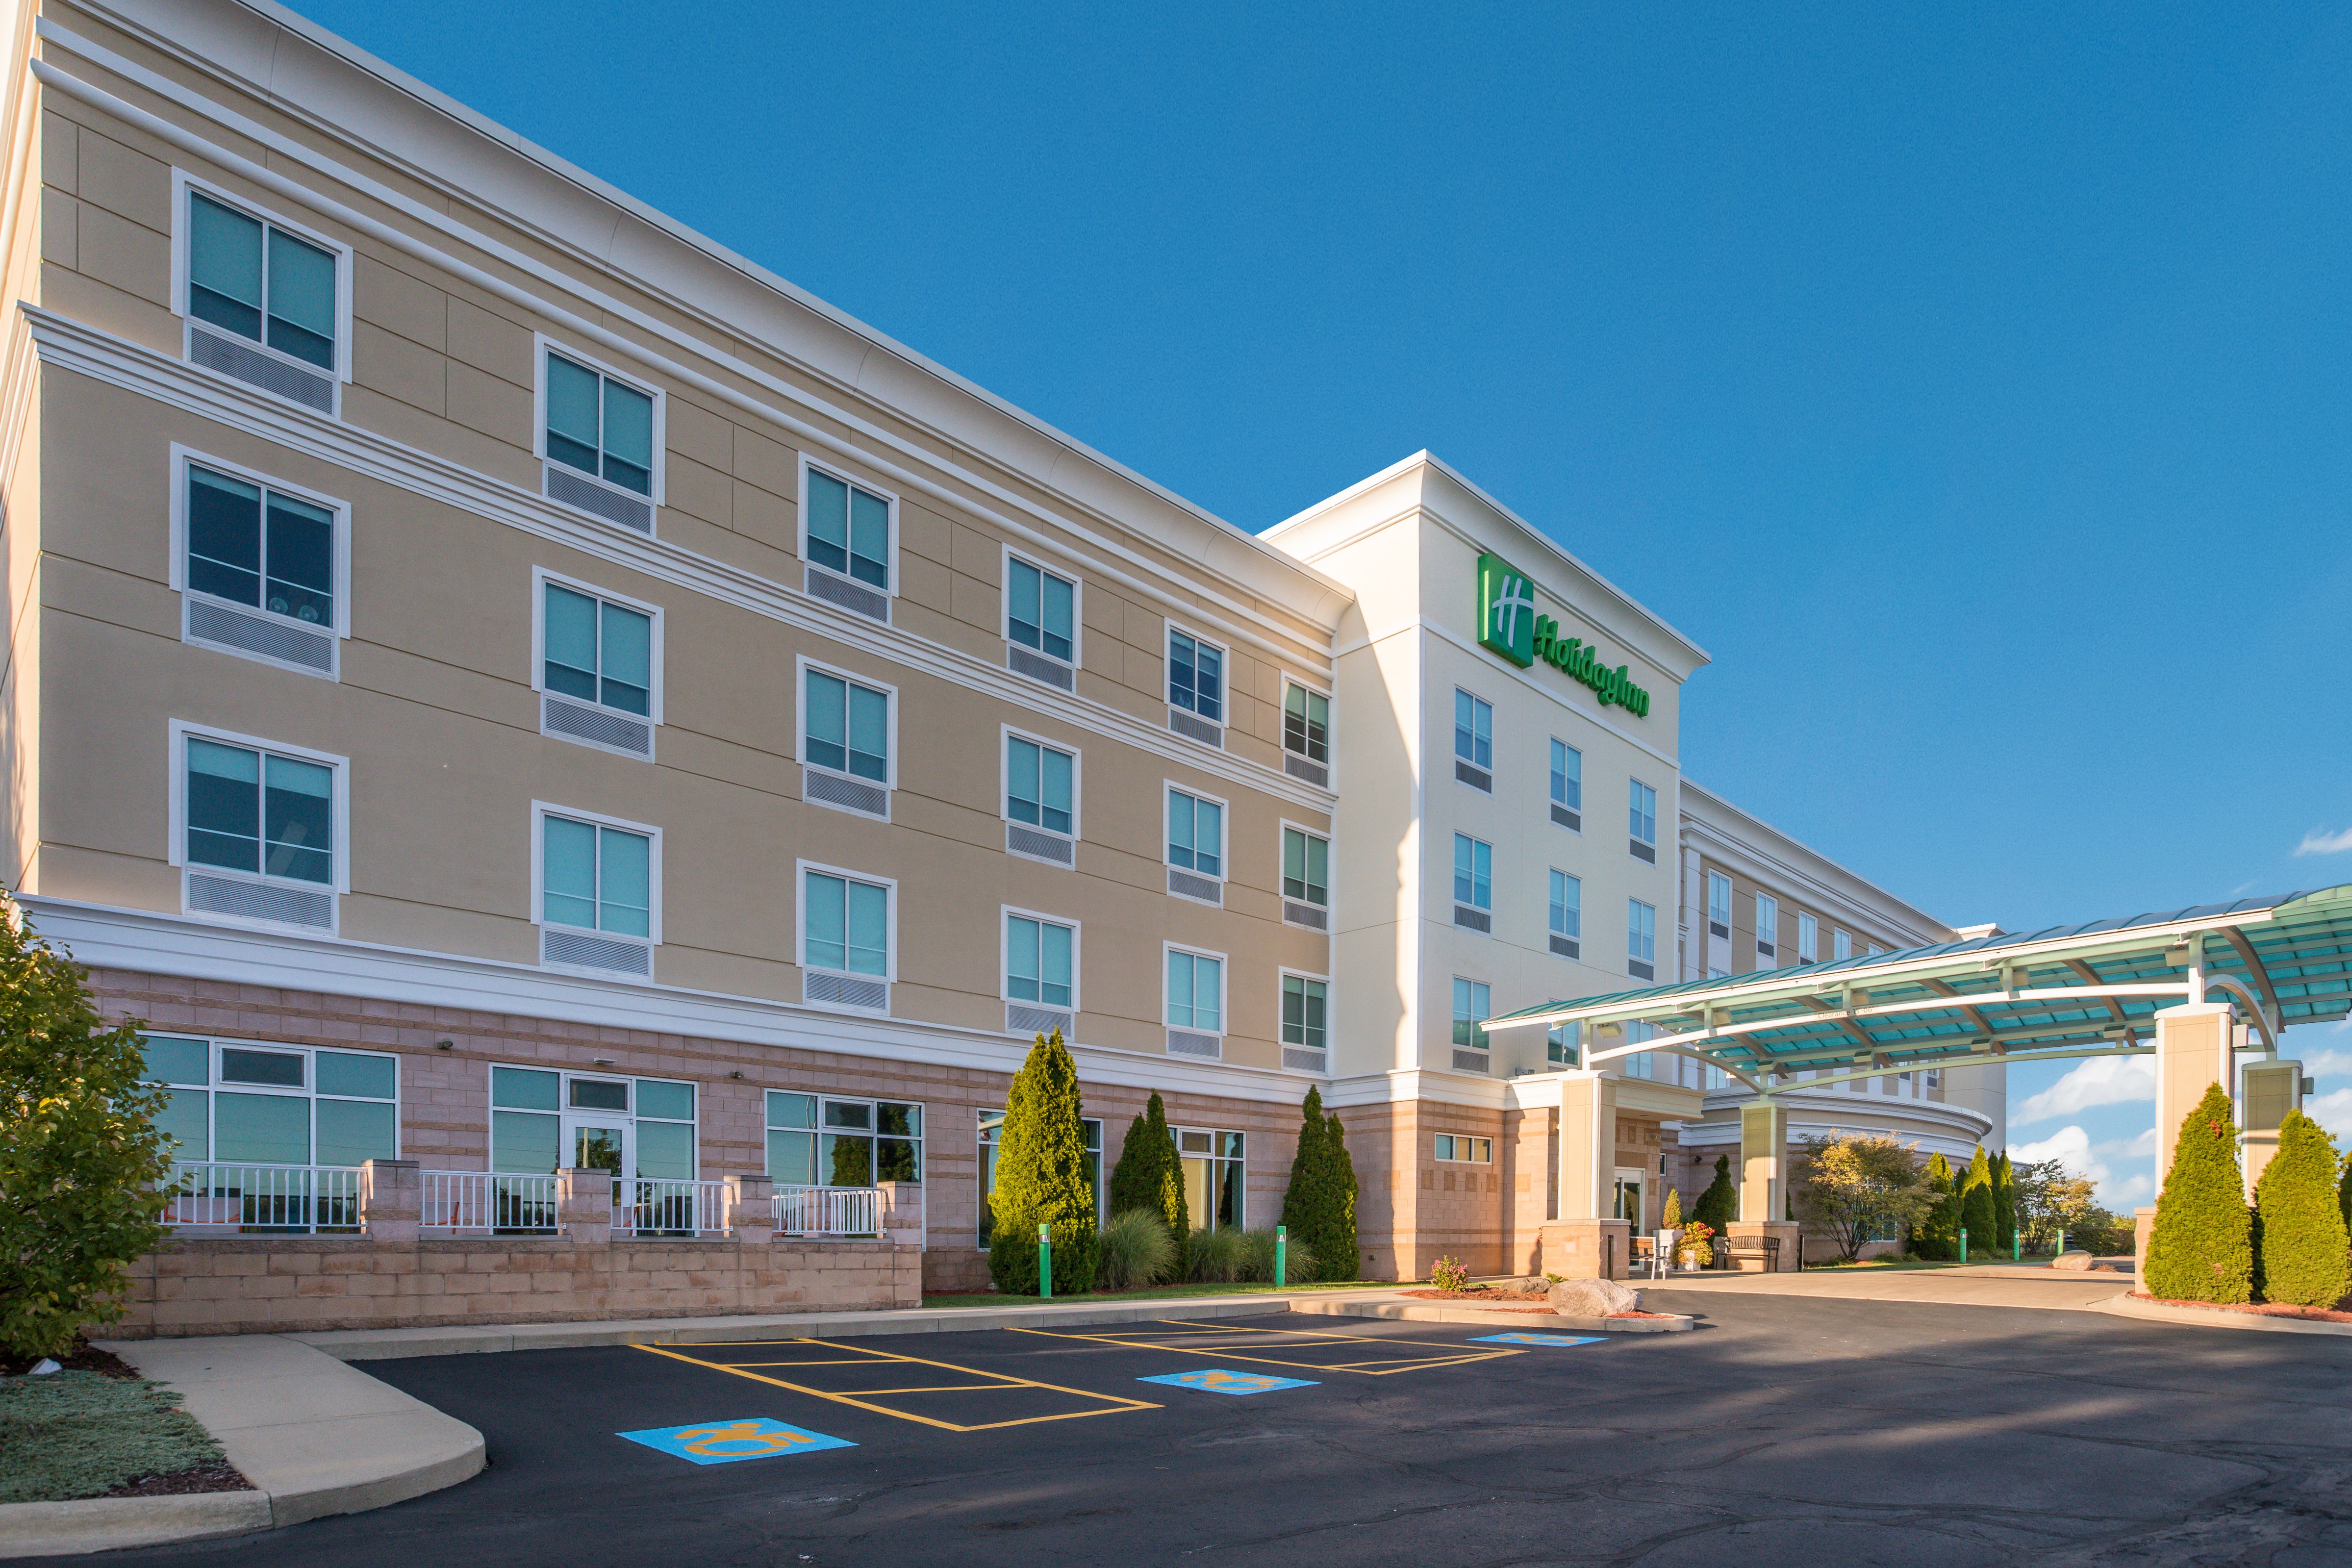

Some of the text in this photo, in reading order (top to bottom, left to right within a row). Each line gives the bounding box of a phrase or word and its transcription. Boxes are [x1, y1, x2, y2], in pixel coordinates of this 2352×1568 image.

[1533, 613, 1649, 718] Holiday Inn
[1818, 1011, 1850, 1019] Clearance
